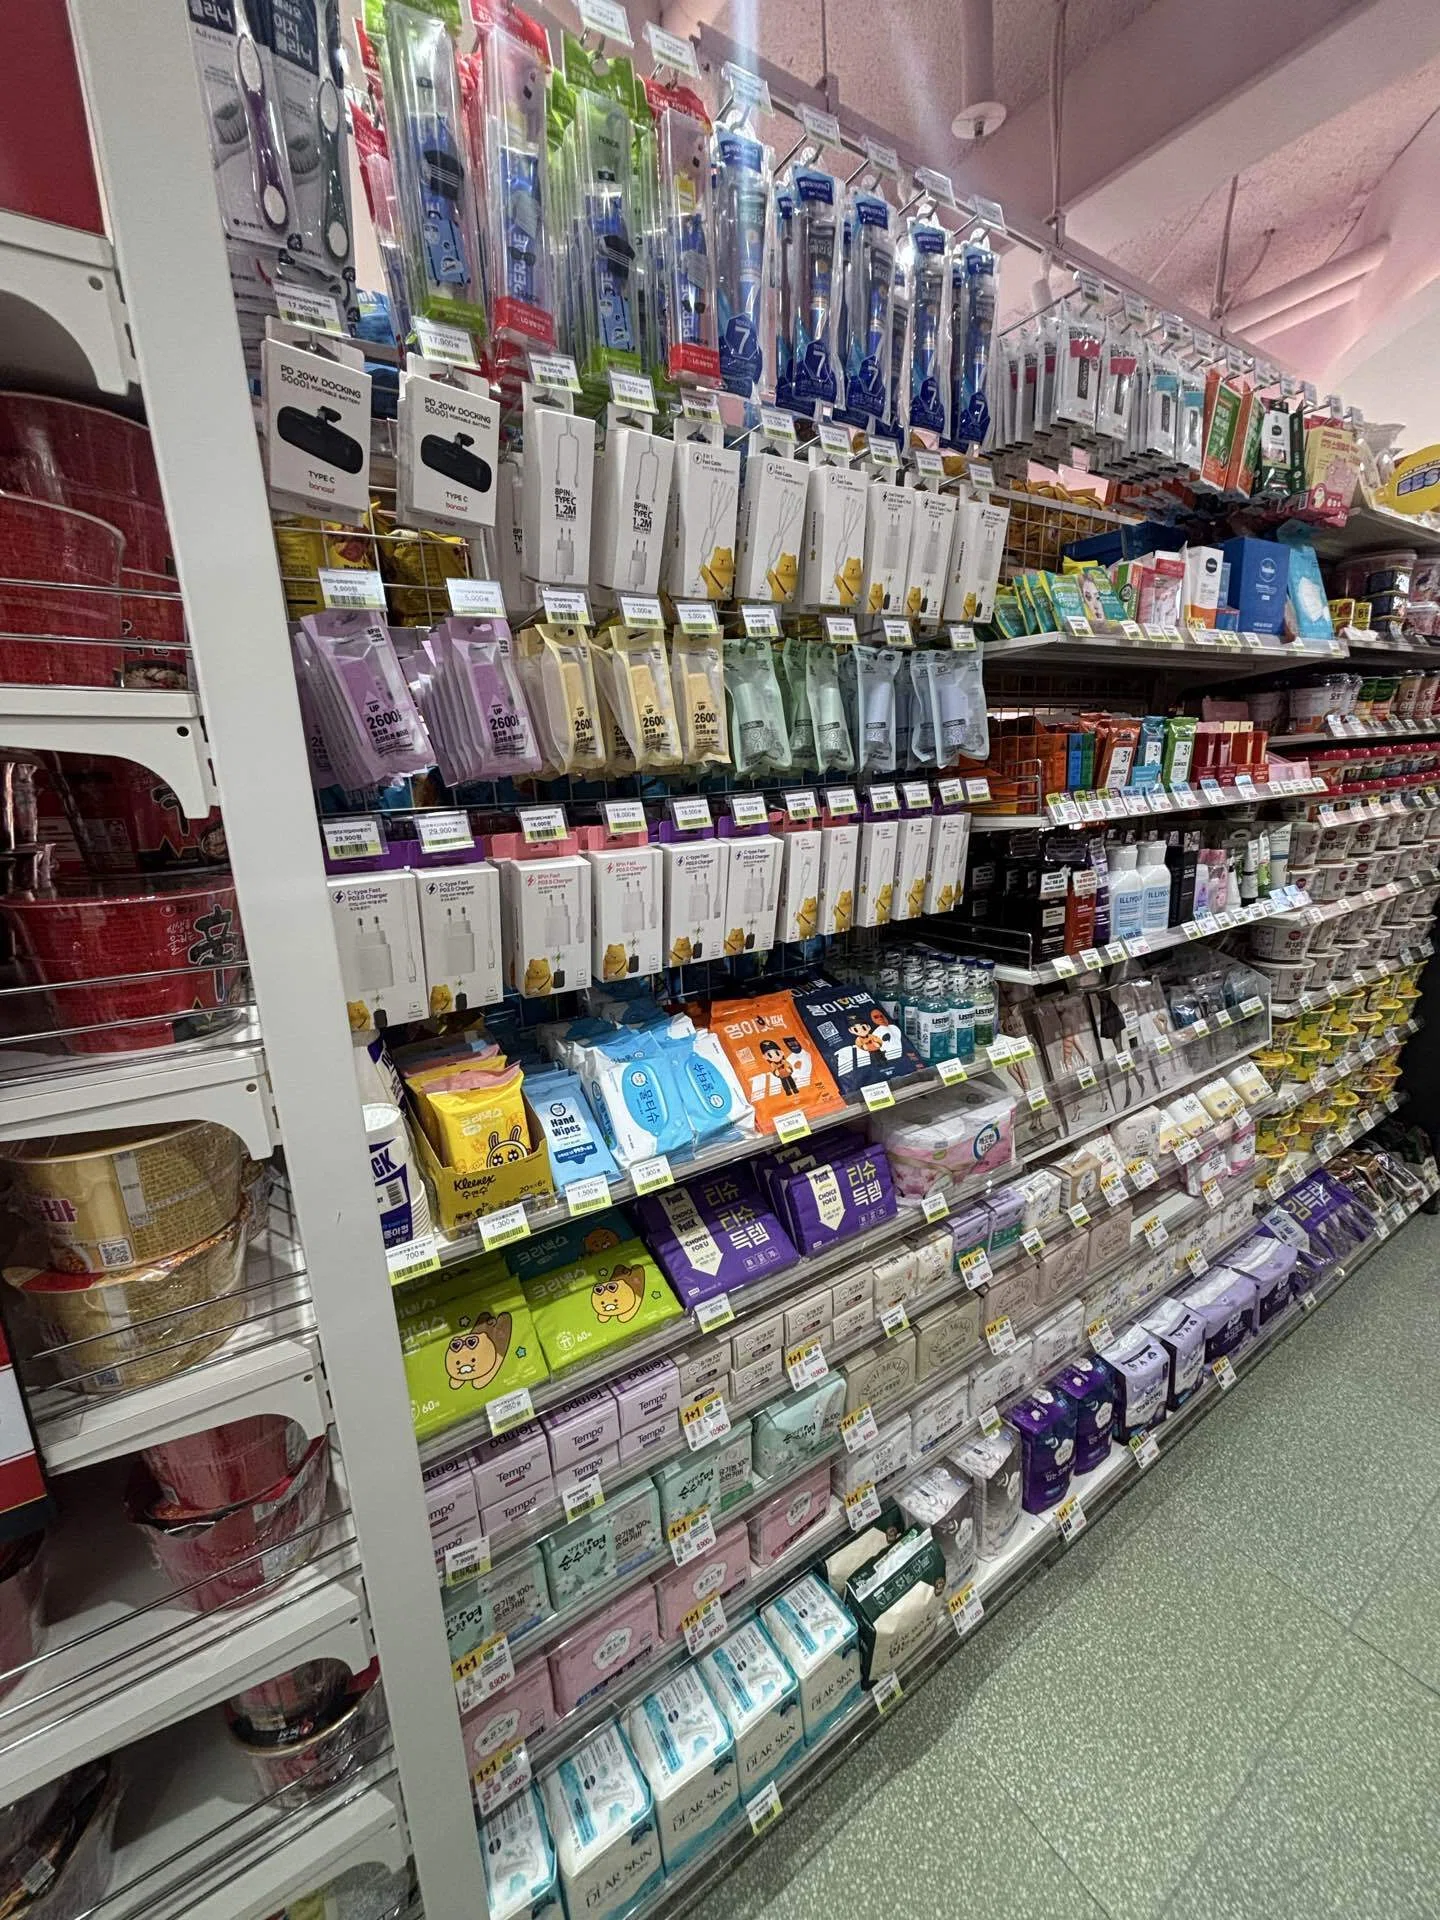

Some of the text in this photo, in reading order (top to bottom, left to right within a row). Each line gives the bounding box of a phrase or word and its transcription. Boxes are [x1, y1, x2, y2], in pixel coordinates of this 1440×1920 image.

[281, 364, 361, 399] PD 20W DOCKING
[425, 397, 491, 424] PD 20W DOCKING
[308, 470, 336, 484] TYPE C
[446, 491, 462, 502] TYPE
[554, 504, 577, 516] 1.2M
[632, 517, 653, 529] 1.2M
[369, 704, 380, 713] UP
[694, 713, 715, 723] 2600
[367, 710, 398, 730] 2600
[490, 715, 517, 730] 2600
[574, 719, 592, 730] 2600
[643, 716, 664, 728] 2600
[550, 1114, 576, 1128] Hand
[552, 1124, 581, 1137] Wipes
[371, 1148, 398, 1179] CK
[453, 1174, 497, 1191] Kleenex
[846, 1160, 876, 1187] 티슈
[704, 1181, 740, 1207] 티슈
[818, 1189, 837, 1200] CHOICE
[852, 1180, 883, 1206] 득템
[718, 1205, 756, 1232] 티슈
[685, 1234, 708, 1248] CHOICE
[729, 1221, 770, 1250] 득템
[788, 1351, 802, 1365] 1+1
[627, 1357, 668, 1381] Tempo
[563, 1389, 607, 1412] Tempo
[639, 1391, 668, 1411] Tempo
[685, 1407, 701, 1422] 1+1
[489, 1423, 538, 1448] Tempo
[572, 1426, 604, 1446] Tempo
[638, 1425, 666, 1444] Tempo
[496, 1461, 532, 1483] Tempo
[572, 1458, 604, 1479] Tempo
[503, 1496, 537, 1518] Tempo
[671, 1522, 687, 1537] 1+1
[684, 1610, 699, 1627] 1+1
[456, 1657, 478, 1677] 1+1
[836, 1667, 855, 1685] SKIN
[476, 1760, 497, 1781] 1+1
